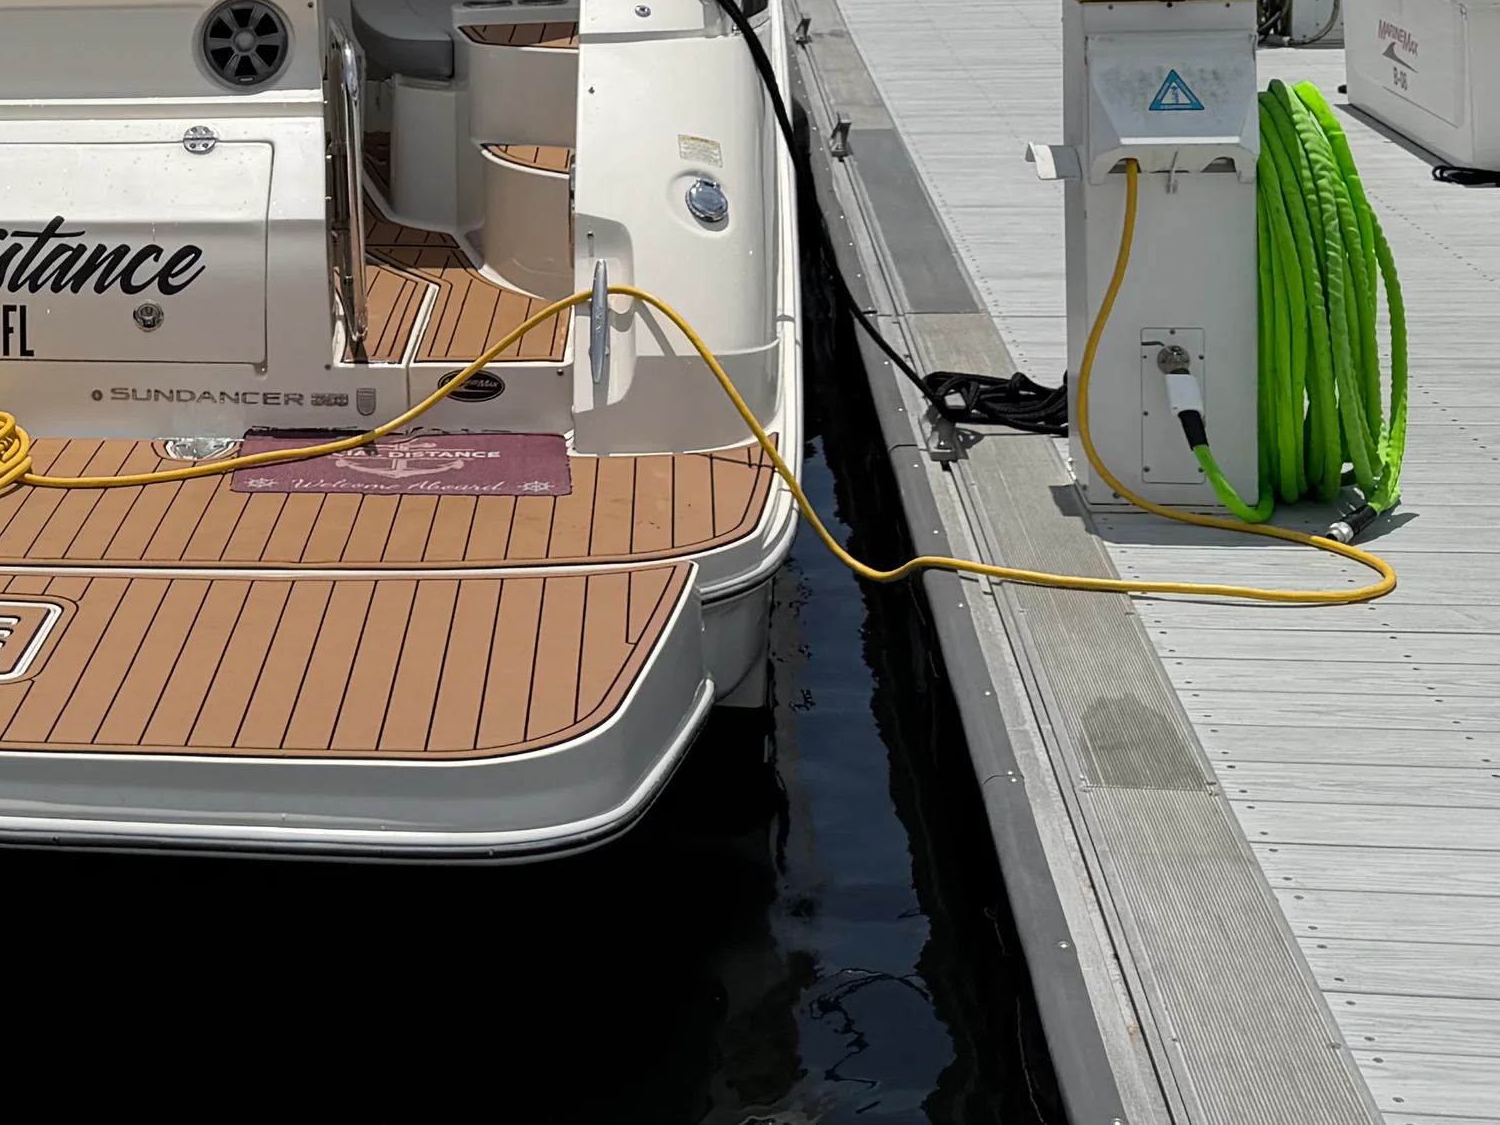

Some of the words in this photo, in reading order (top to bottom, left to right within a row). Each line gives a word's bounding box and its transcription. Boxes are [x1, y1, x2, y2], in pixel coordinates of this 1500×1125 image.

[2, 304, 35, 357] FL
[110, 387, 304, 407] SUNDANCER
[292, 478, 399, 491] Welcome
[407, 480, 505, 491] Aboard
